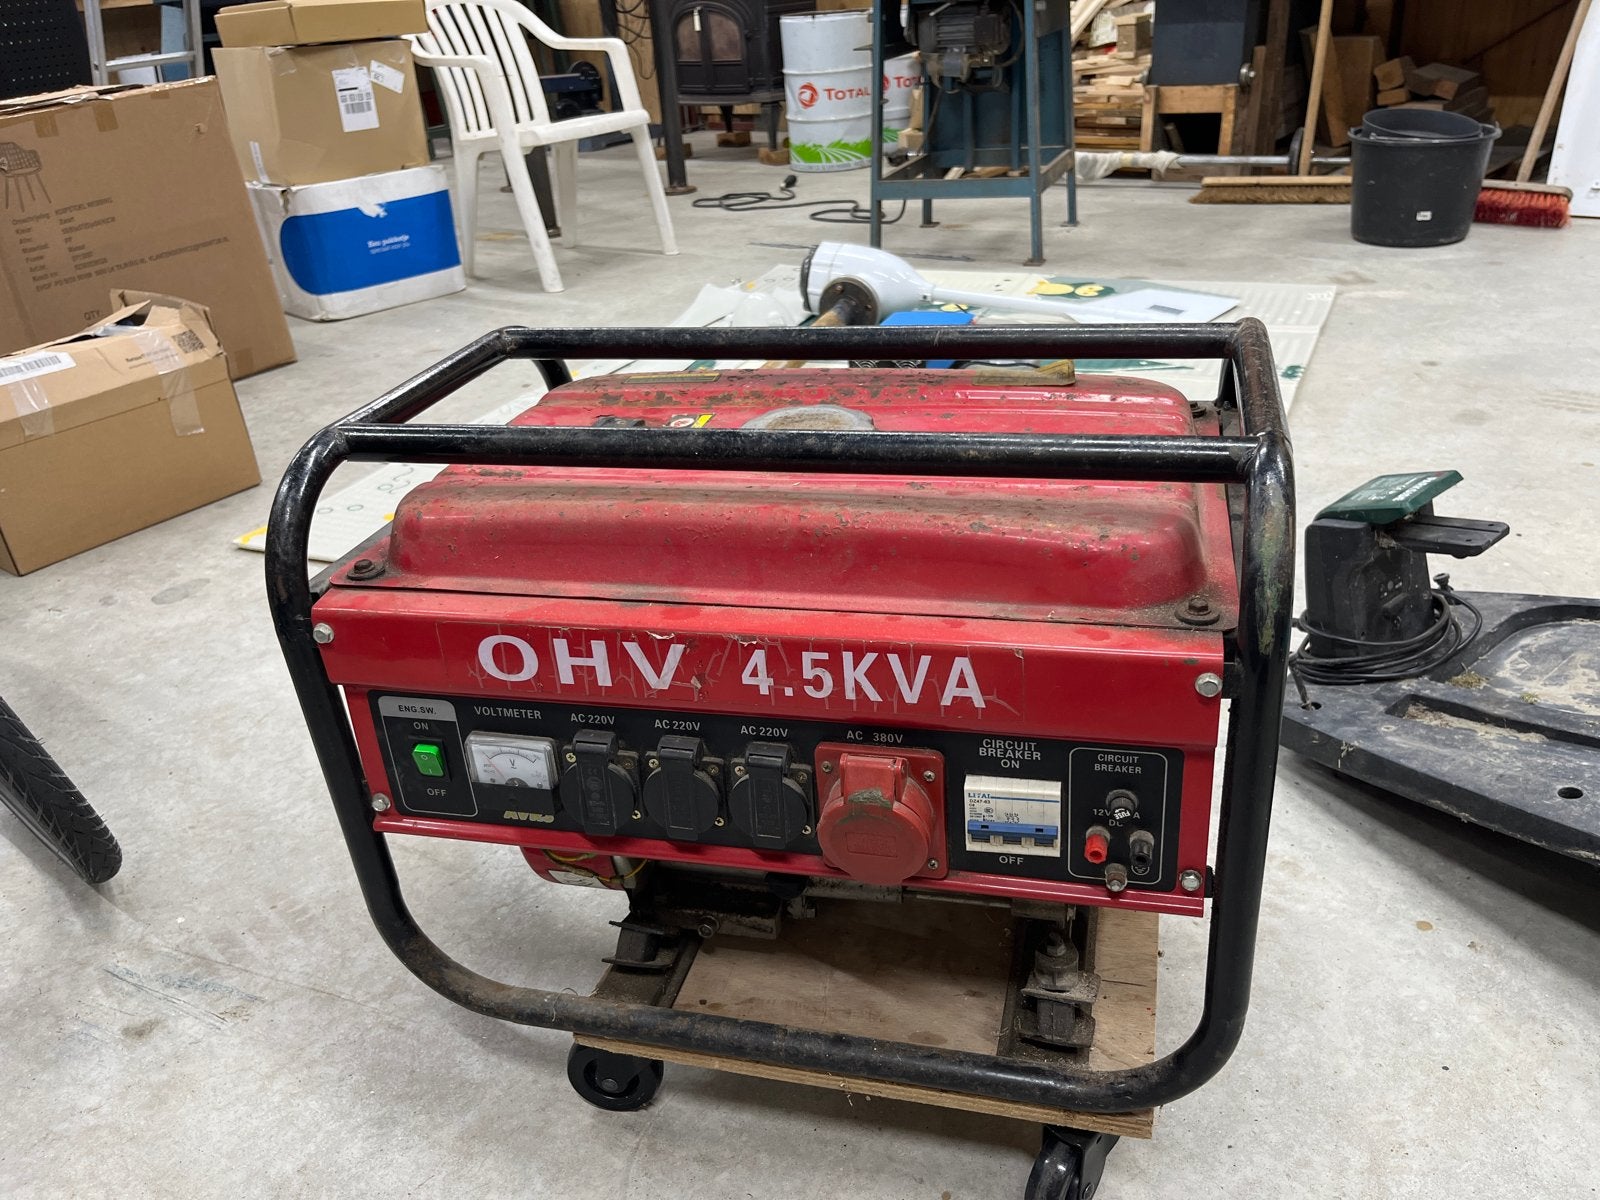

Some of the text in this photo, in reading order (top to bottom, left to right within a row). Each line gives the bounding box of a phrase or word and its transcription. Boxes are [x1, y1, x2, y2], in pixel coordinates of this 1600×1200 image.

[823, 87, 871, 101] TOTAL
[477, 634, 686, 690] OHV
[740, 649, 986, 709] 4.5KVA
[474, 705, 542, 720] VOLTMETER
[570, 712, 615, 725] AC 220V
[413, 721, 429, 731] ON
[654, 718, 701, 731] AC 220V
[740, 725, 788, 738] AC 220V
[846, 730, 903, 744] AC 380V
[982, 738, 1037, 752] CIRCUIT
[979, 747, 1041, 761] BREAKER
[1097, 753, 1140, 764] CIRCUIT
[1000, 758, 1020, 769] ON
[1094, 763, 1142, 774] BREAKER
[426, 787, 447, 797] OFF
[1113, 809, 1131, 820] FUSE
[999, 854, 1024, 865] OFF
